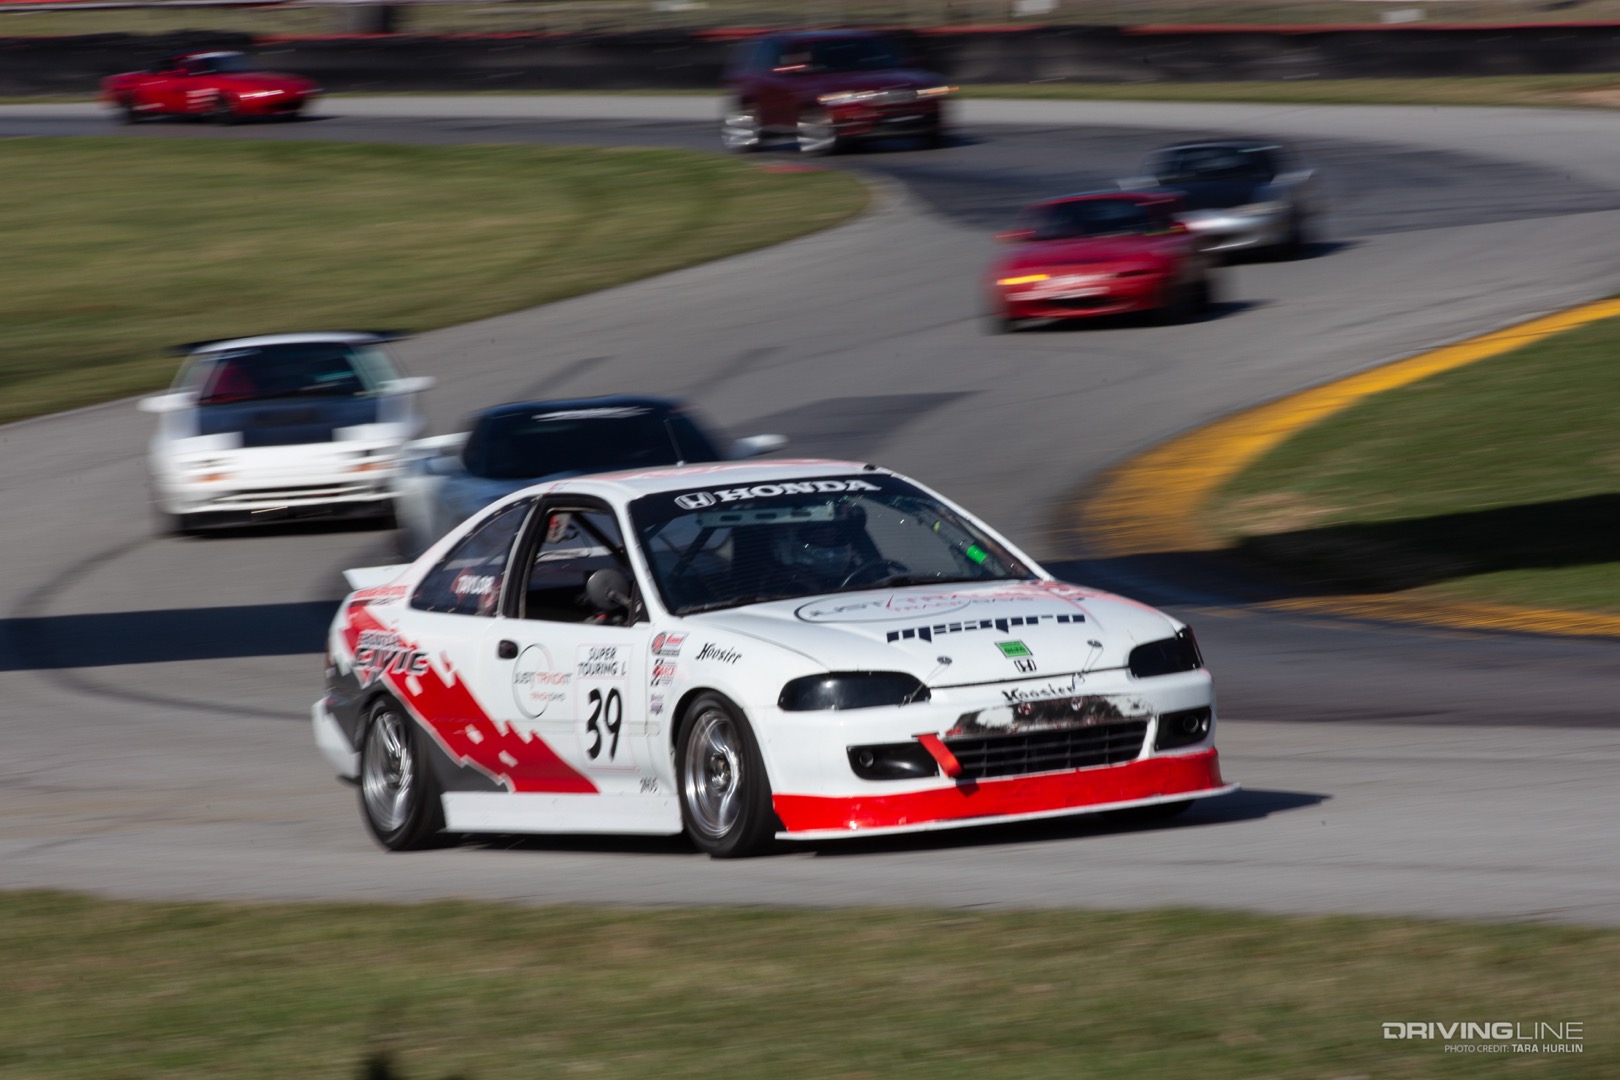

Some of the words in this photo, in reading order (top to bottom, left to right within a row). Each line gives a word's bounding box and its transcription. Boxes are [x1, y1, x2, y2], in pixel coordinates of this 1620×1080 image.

[714, 479, 882, 502] HONDA
[455, 574, 496, 595] TAYLOR
[354, 647, 431, 680] CIVIC
[588, 647, 617, 661] SUPER
[696, 642, 742, 665] Hoosier
[578, 661, 618, 677] TOURING
[585, 686, 622, 763] 39
